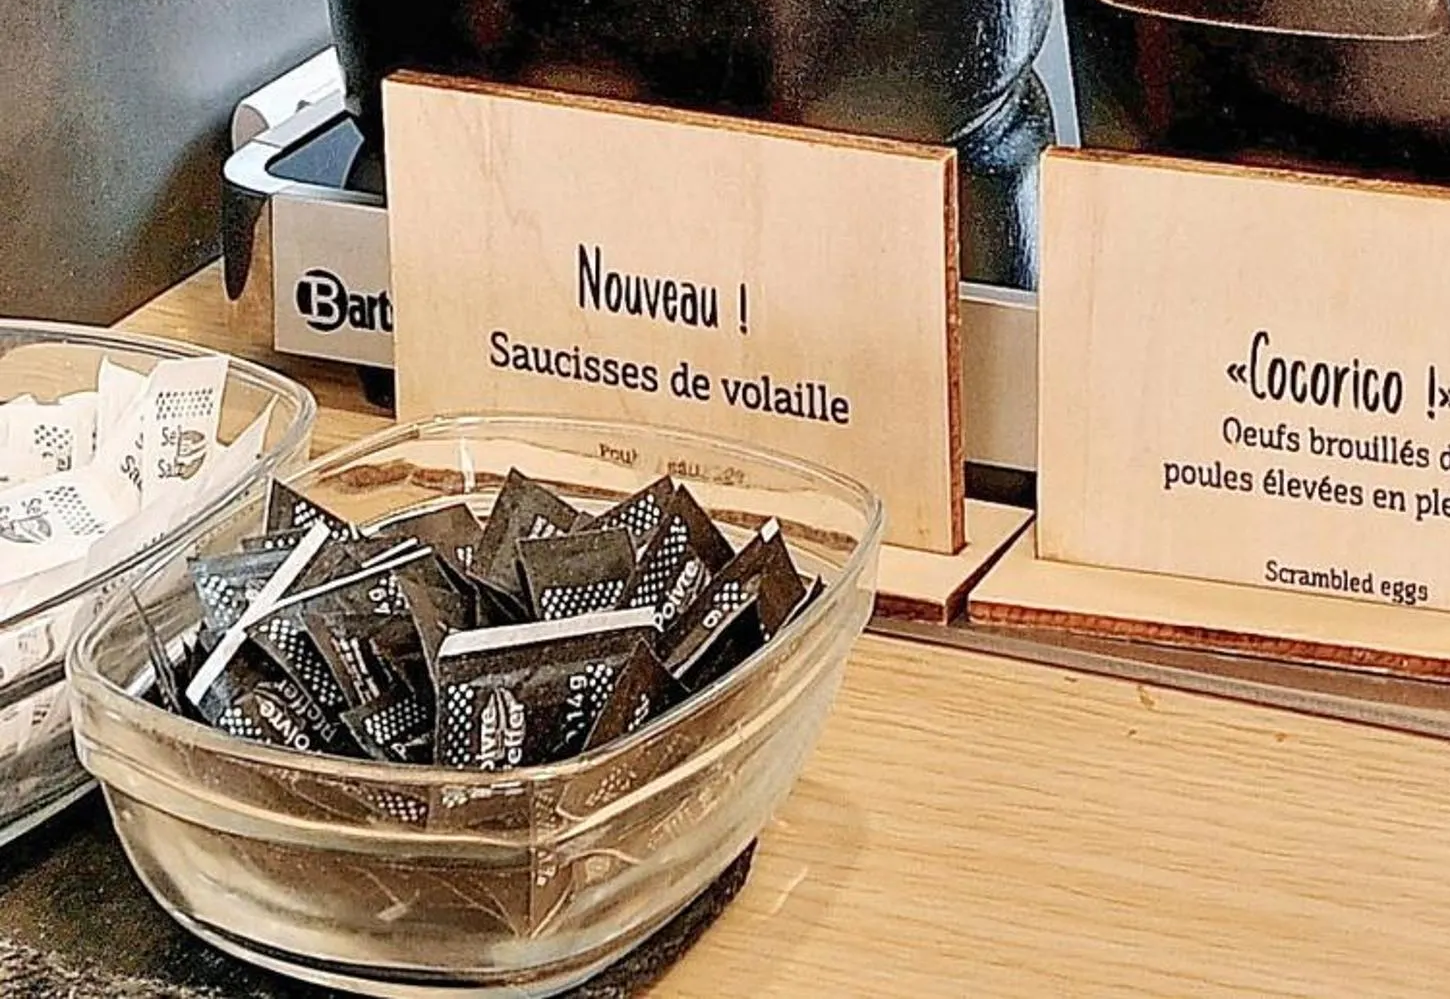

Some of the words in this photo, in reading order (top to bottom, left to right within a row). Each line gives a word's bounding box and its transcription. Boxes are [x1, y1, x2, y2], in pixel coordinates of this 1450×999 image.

[578, 243, 719, 329] Nouveau
[490, 331, 659, 393] Saucisses
[670, 362, 710, 401] de
[721, 375, 849, 425] volaille
[1223, 416, 1300, 453] Oeufs
[1309, 427, 1430, 468] brouillés
[1164, 461, 1253, 492] poules
[1263, 468, 1363, 506] élevées
[1373, 488, 1406, 512] en
[1265, 560, 1374, 594] Scrambled
[1380, 580, 1428, 606] eggs
[258, 698, 311, 751] oivre
